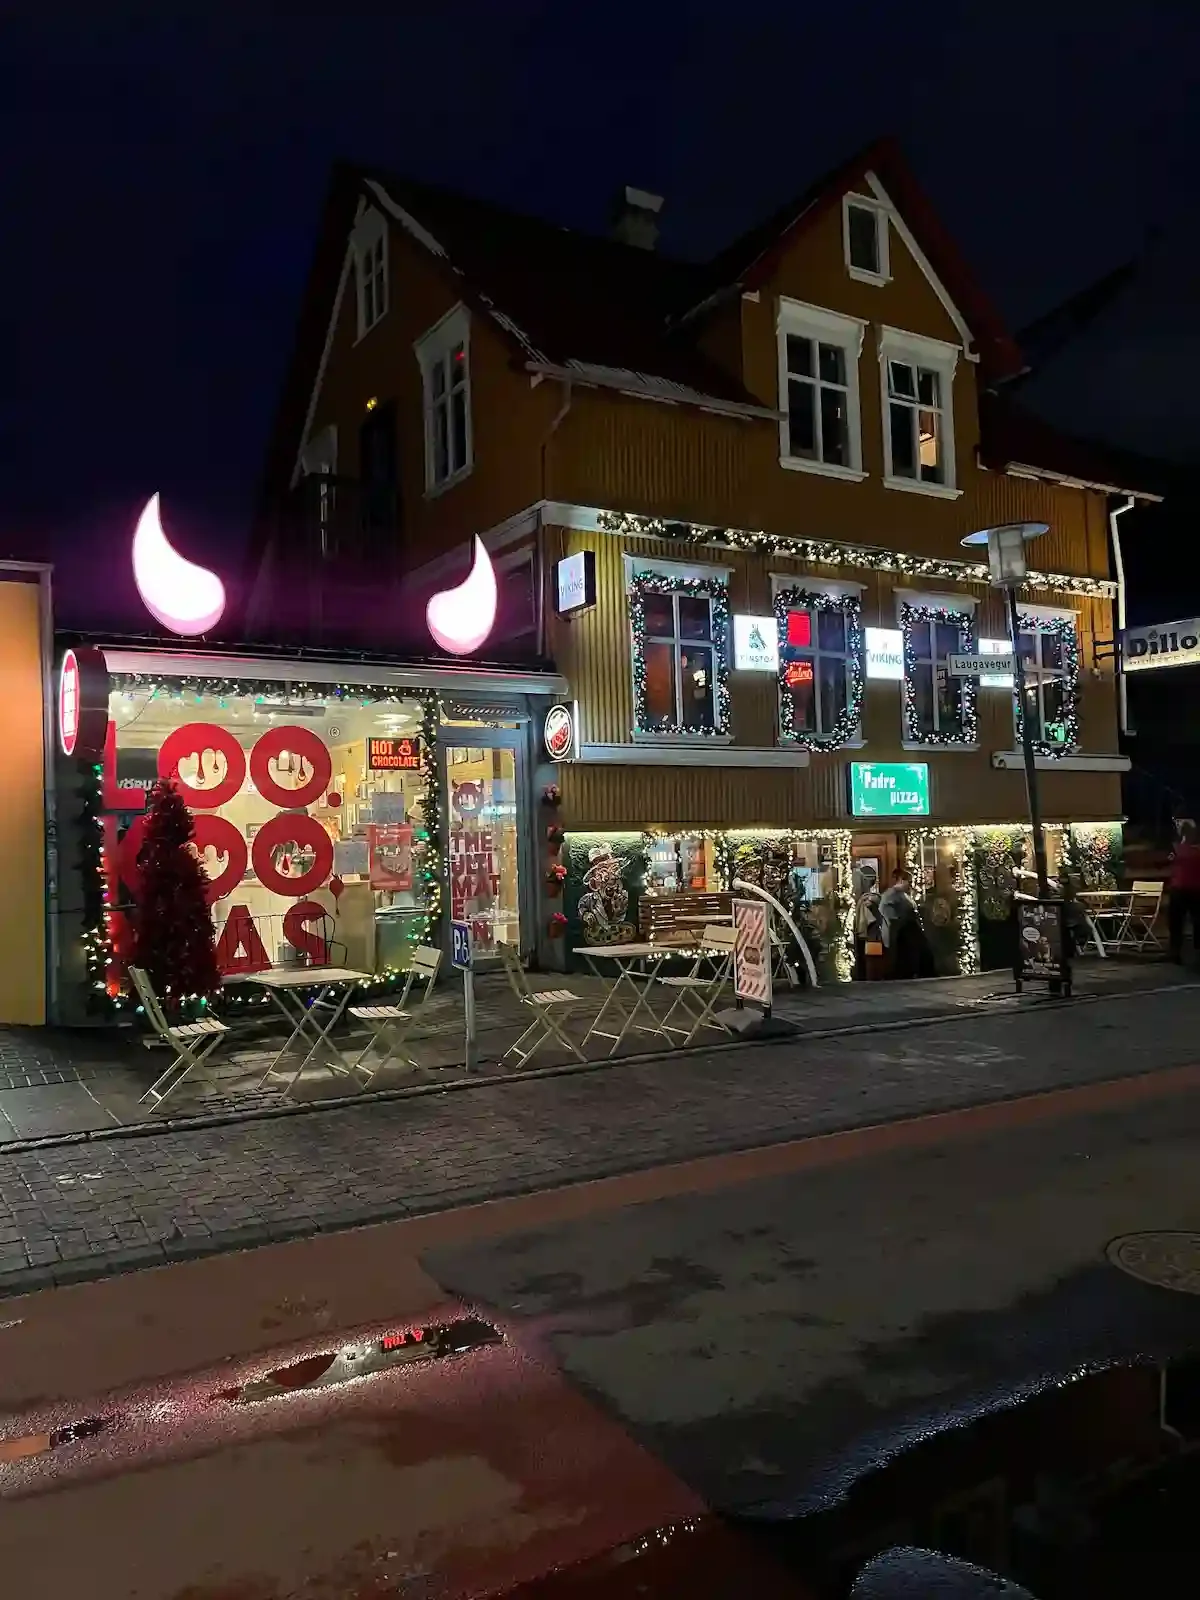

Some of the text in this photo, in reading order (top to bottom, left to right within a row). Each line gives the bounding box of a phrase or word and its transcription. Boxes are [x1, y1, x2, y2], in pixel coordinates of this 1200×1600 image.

[868, 652, 903, 665] VIKING
[955, 659, 1011, 670] Laugavegur
[371, 740, 394, 755] HOT
[371, 755, 419, 767] CHOCOLATE
[864, 771, 896, 789] Padre
[890, 787, 919, 807] pizza
